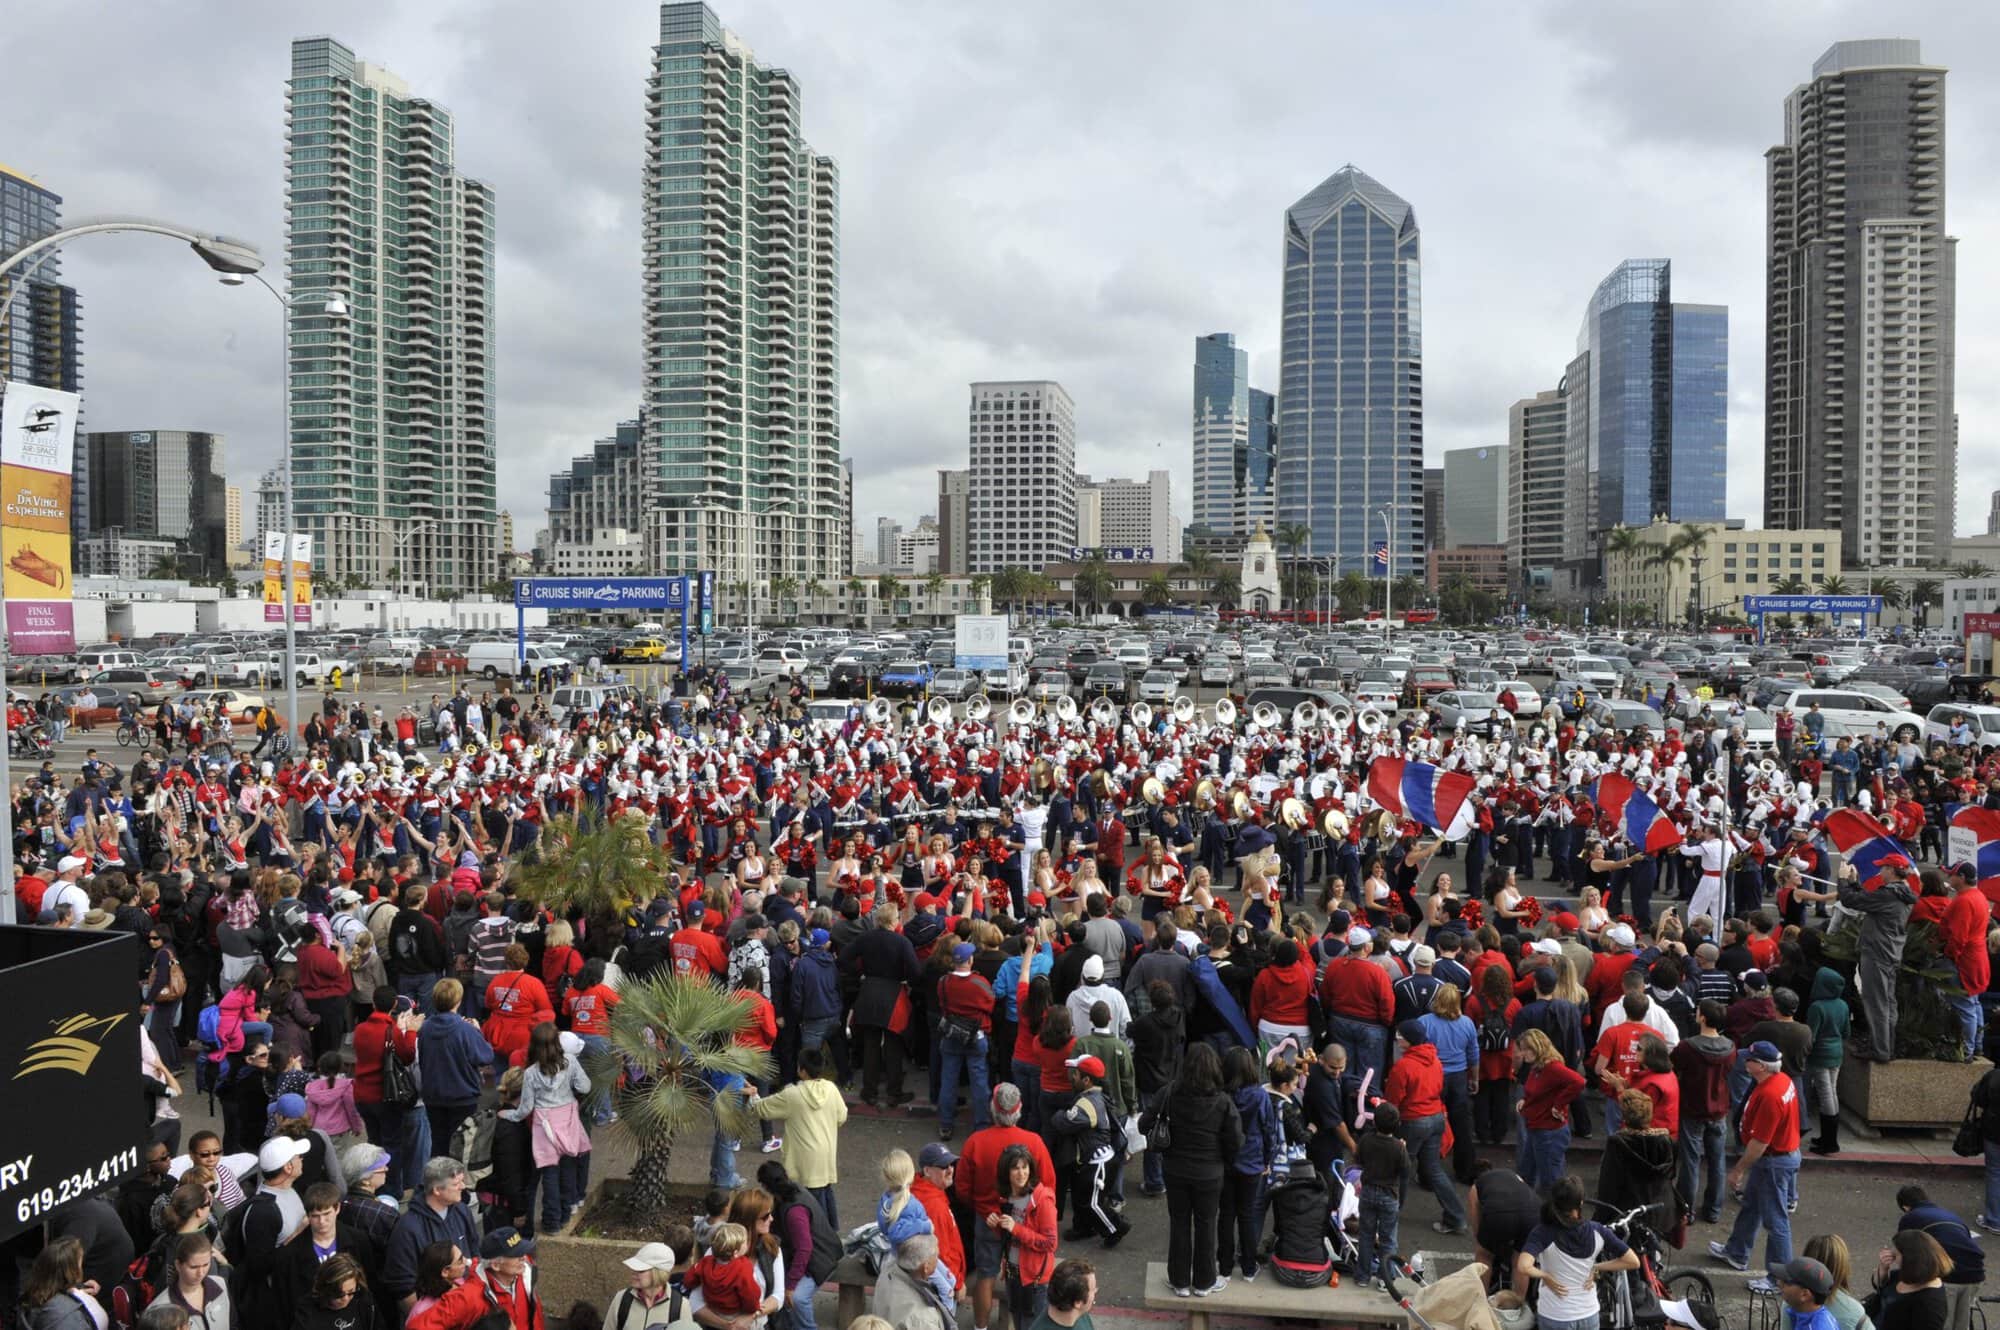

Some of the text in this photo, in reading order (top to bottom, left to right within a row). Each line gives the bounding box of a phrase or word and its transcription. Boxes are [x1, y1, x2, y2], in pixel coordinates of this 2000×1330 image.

[1073, 548, 1151, 560] Sata Fe
[521, 583, 530, 596] 5
[671, 582, 680, 596] 5
[704, 573, 711, 596] 5
[535, 587, 570, 599] CRUISE
[572, 587, 594, 599] SHIP
[622, 587, 666, 599] PARKING
[1759, 600, 1867, 608] CRUISE SHIP PARKING
[28, 606, 54, 616] FINAL
[26, 617, 56, 626] WEEKS
[704, 613, 710, 630] P
[17, 1145, 138, 1222] 619.234.4111
